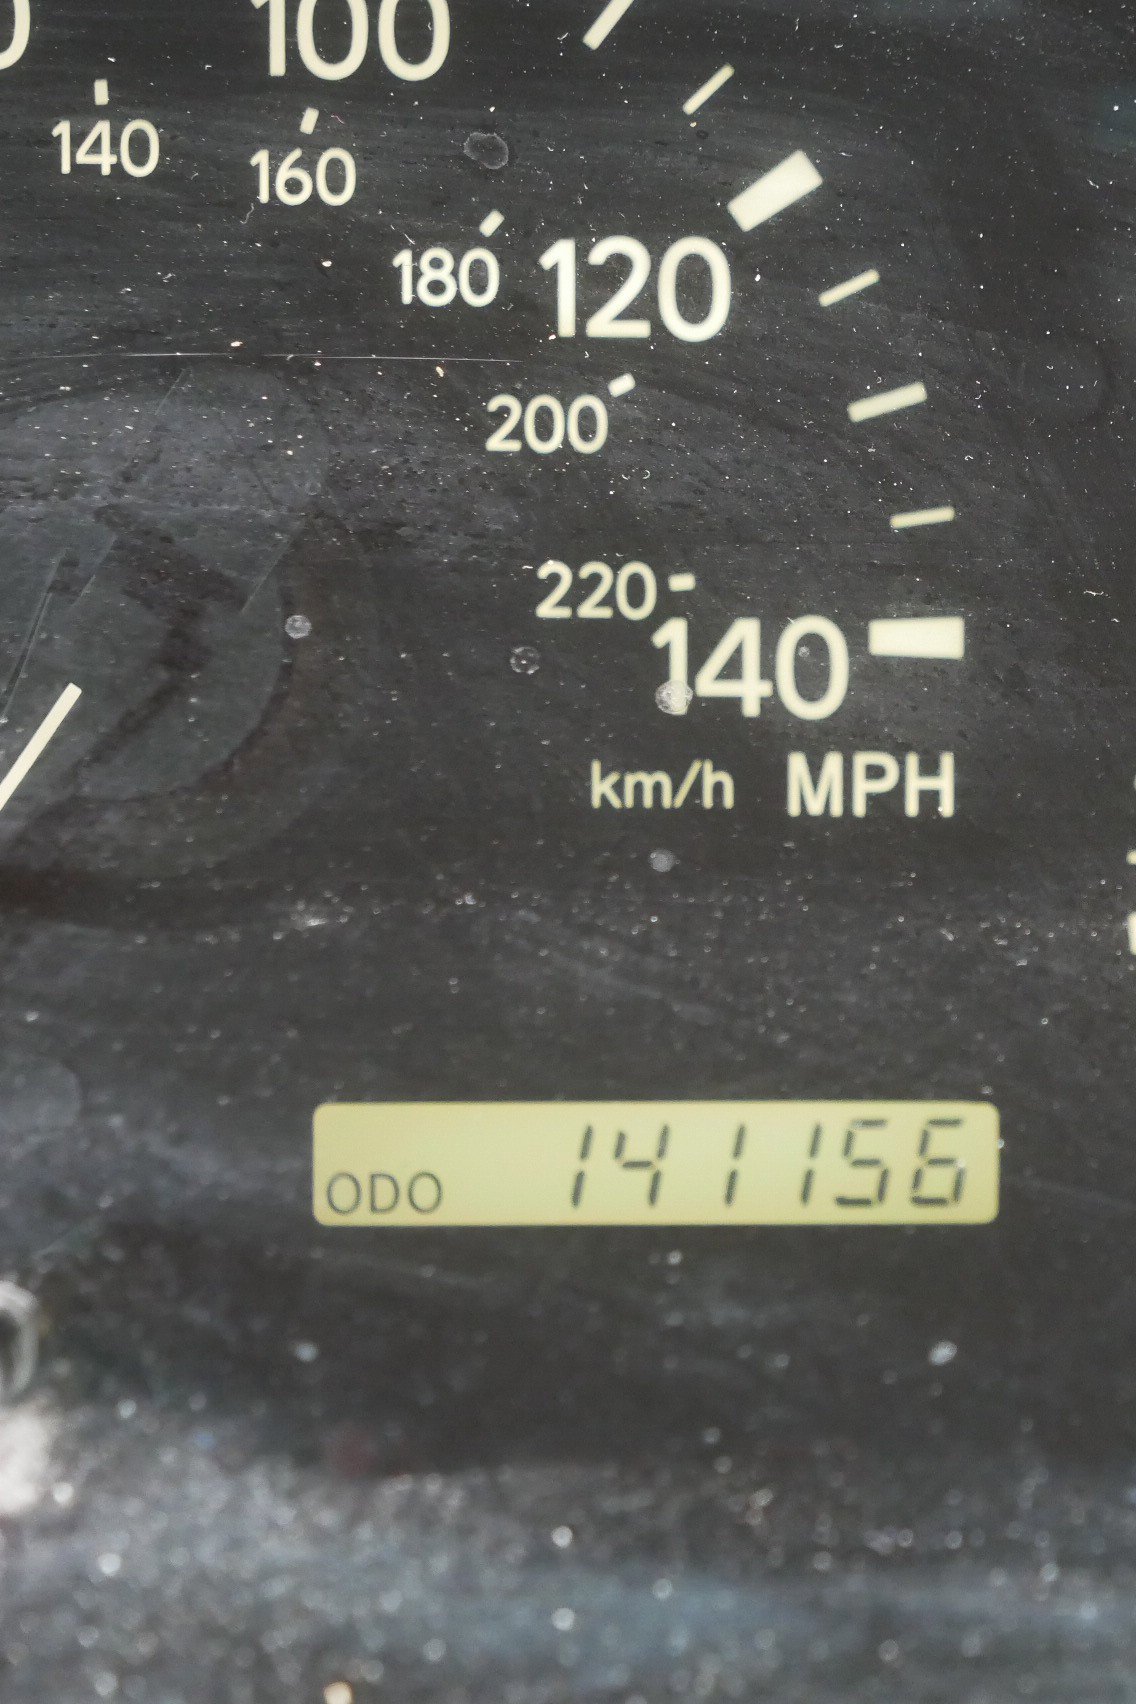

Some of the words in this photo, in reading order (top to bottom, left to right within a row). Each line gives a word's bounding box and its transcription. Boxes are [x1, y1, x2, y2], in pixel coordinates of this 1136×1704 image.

[251, 0, 450, 81] 100
[52, 119, 159, 177] 140
[250, 148, 356, 206] 160
[393, 247, 499, 307] 180
[540, 236, 732, 342] 120
[486, 395, 608, 453] 200
[536, 560, 656, 620] 220
[653, 615, 849, 720] 140
[591, 760, 734, 809] km/h
[788, 751, 954, 817] MPH
[325, 1171, 443, 1217] ODO
[570, 1117, 966, 1209] 141156
